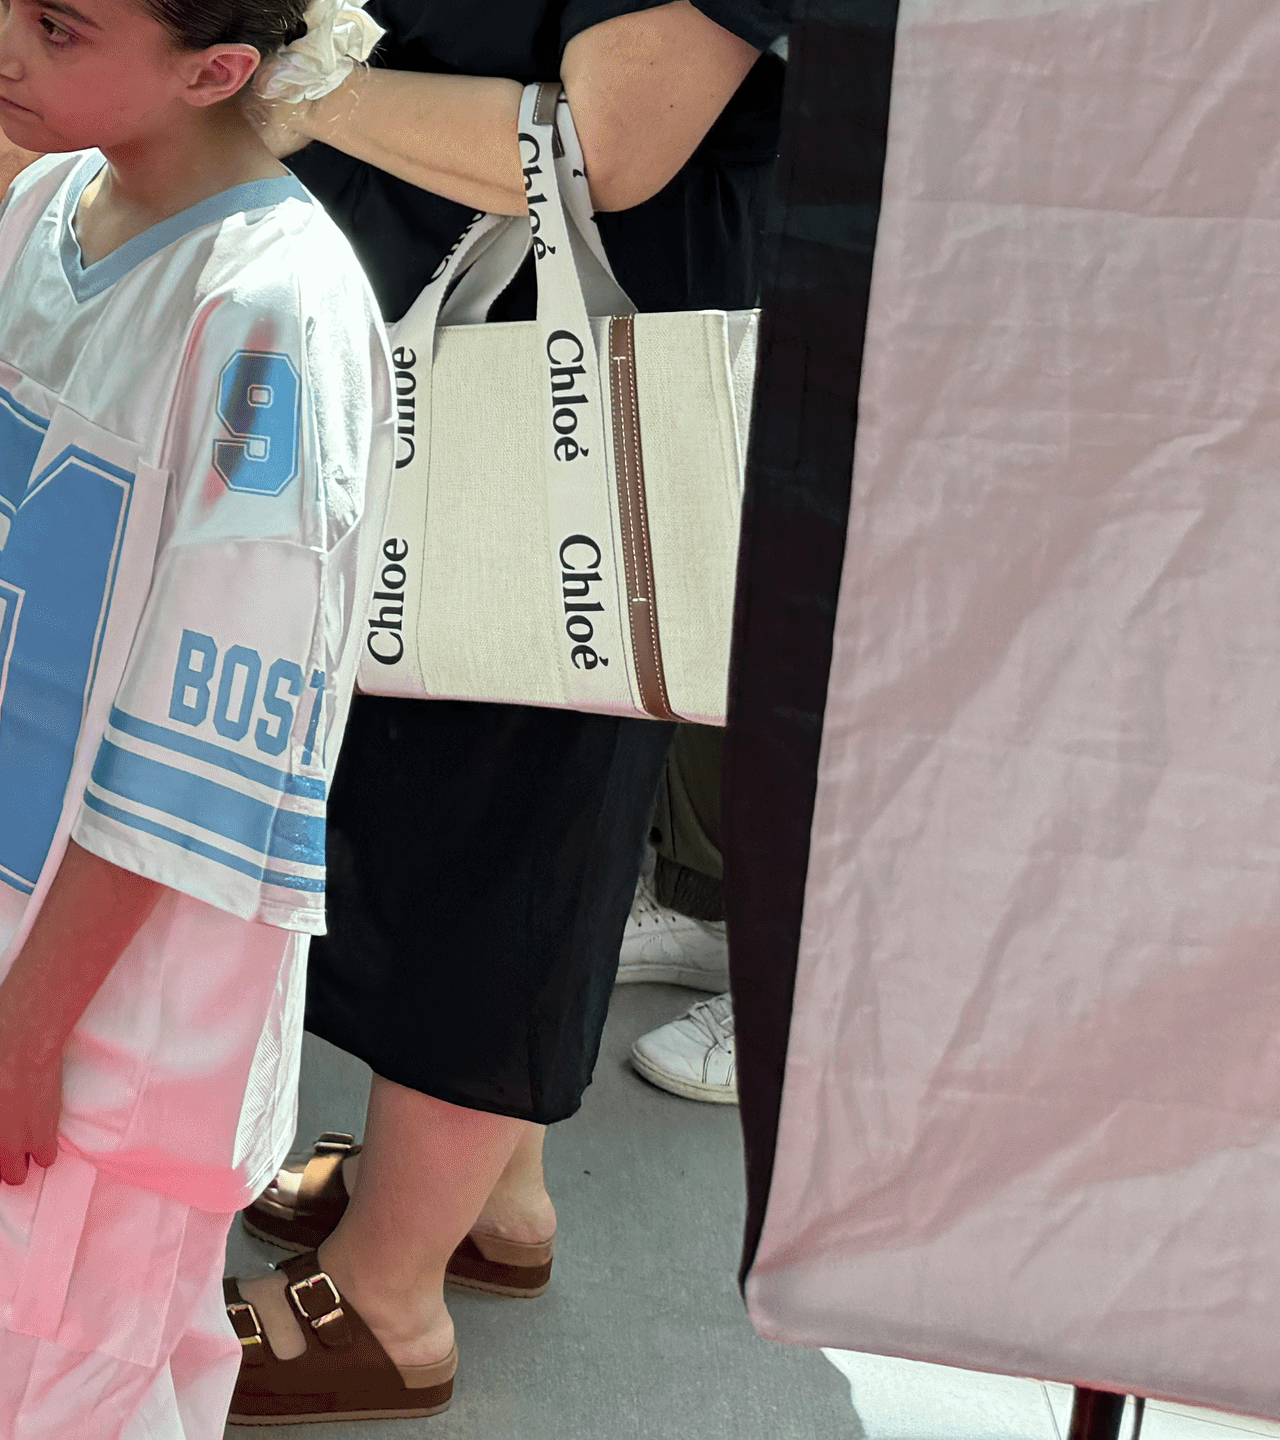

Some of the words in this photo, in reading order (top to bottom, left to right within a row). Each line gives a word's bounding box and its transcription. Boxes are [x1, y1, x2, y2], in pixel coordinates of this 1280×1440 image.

[212, 349, 300, 496] 9
[546, 329, 590, 462] Chloé
[558, 534, 610, 670] Chloé
